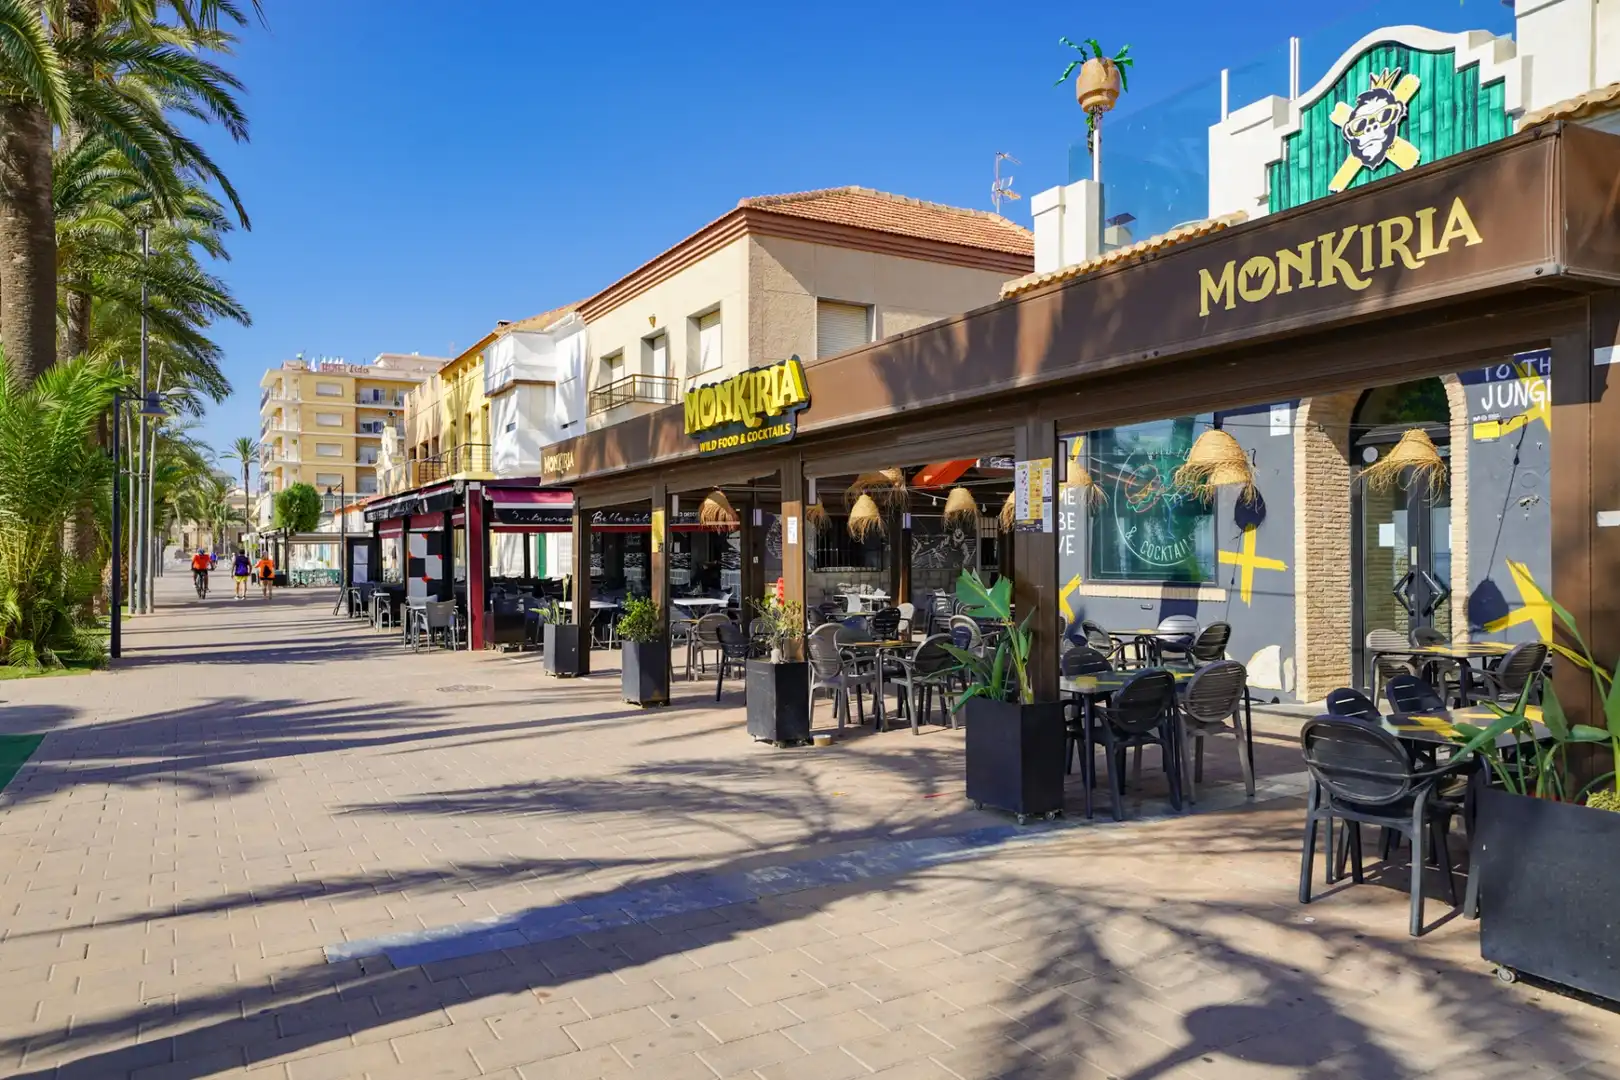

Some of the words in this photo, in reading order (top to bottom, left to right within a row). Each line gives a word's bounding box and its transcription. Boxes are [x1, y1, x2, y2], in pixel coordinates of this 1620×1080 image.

[1199, 196, 1483, 317] MONKIRIA
[1521, 356, 1551, 377] TH
[683, 359, 803, 435] MONKIRIA
[700, 440, 717, 453] WILD
[718, 435, 739, 449] FOOD
[740, 433, 746, 444] &
[747, 423, 792, 443] COCKTAILS
[543, 451, 575, 474] MONKIRIA
